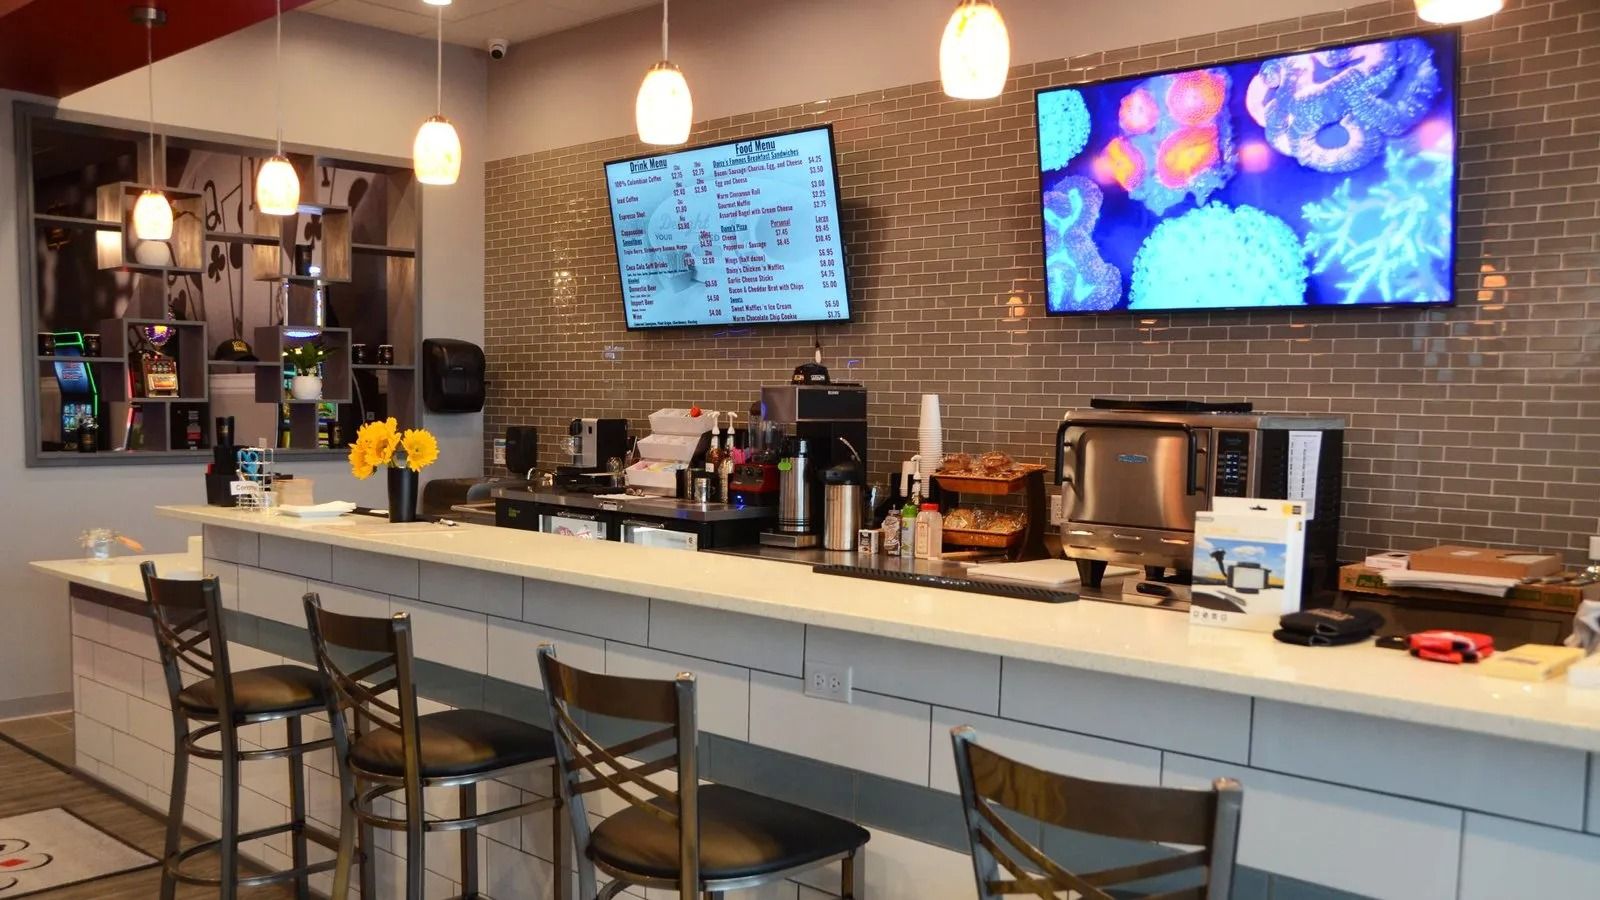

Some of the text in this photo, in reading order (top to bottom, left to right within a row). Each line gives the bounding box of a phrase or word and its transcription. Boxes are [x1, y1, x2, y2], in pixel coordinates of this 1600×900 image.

[736, 139, 776, 154] Food Menu
[730, 158, 746, 166] Famous
[747, 154, 770, 163] Breakfast
[771, 149, 799, 160] Sandwiches
[808, 155, 822, 163] $4.25
[630, 160, 649, 172] Drink
[650, 158, 668, 169] Menu
[809, 166, 823, 174] $3.50
[627, 177, 648, 186] Colombian
[649, 175, 662, 183] Coffee
[811, 180, 825, 188] $3.00
[812, 190, 826, 198] $2.25
[749, 241, 767, 249] Sausage
